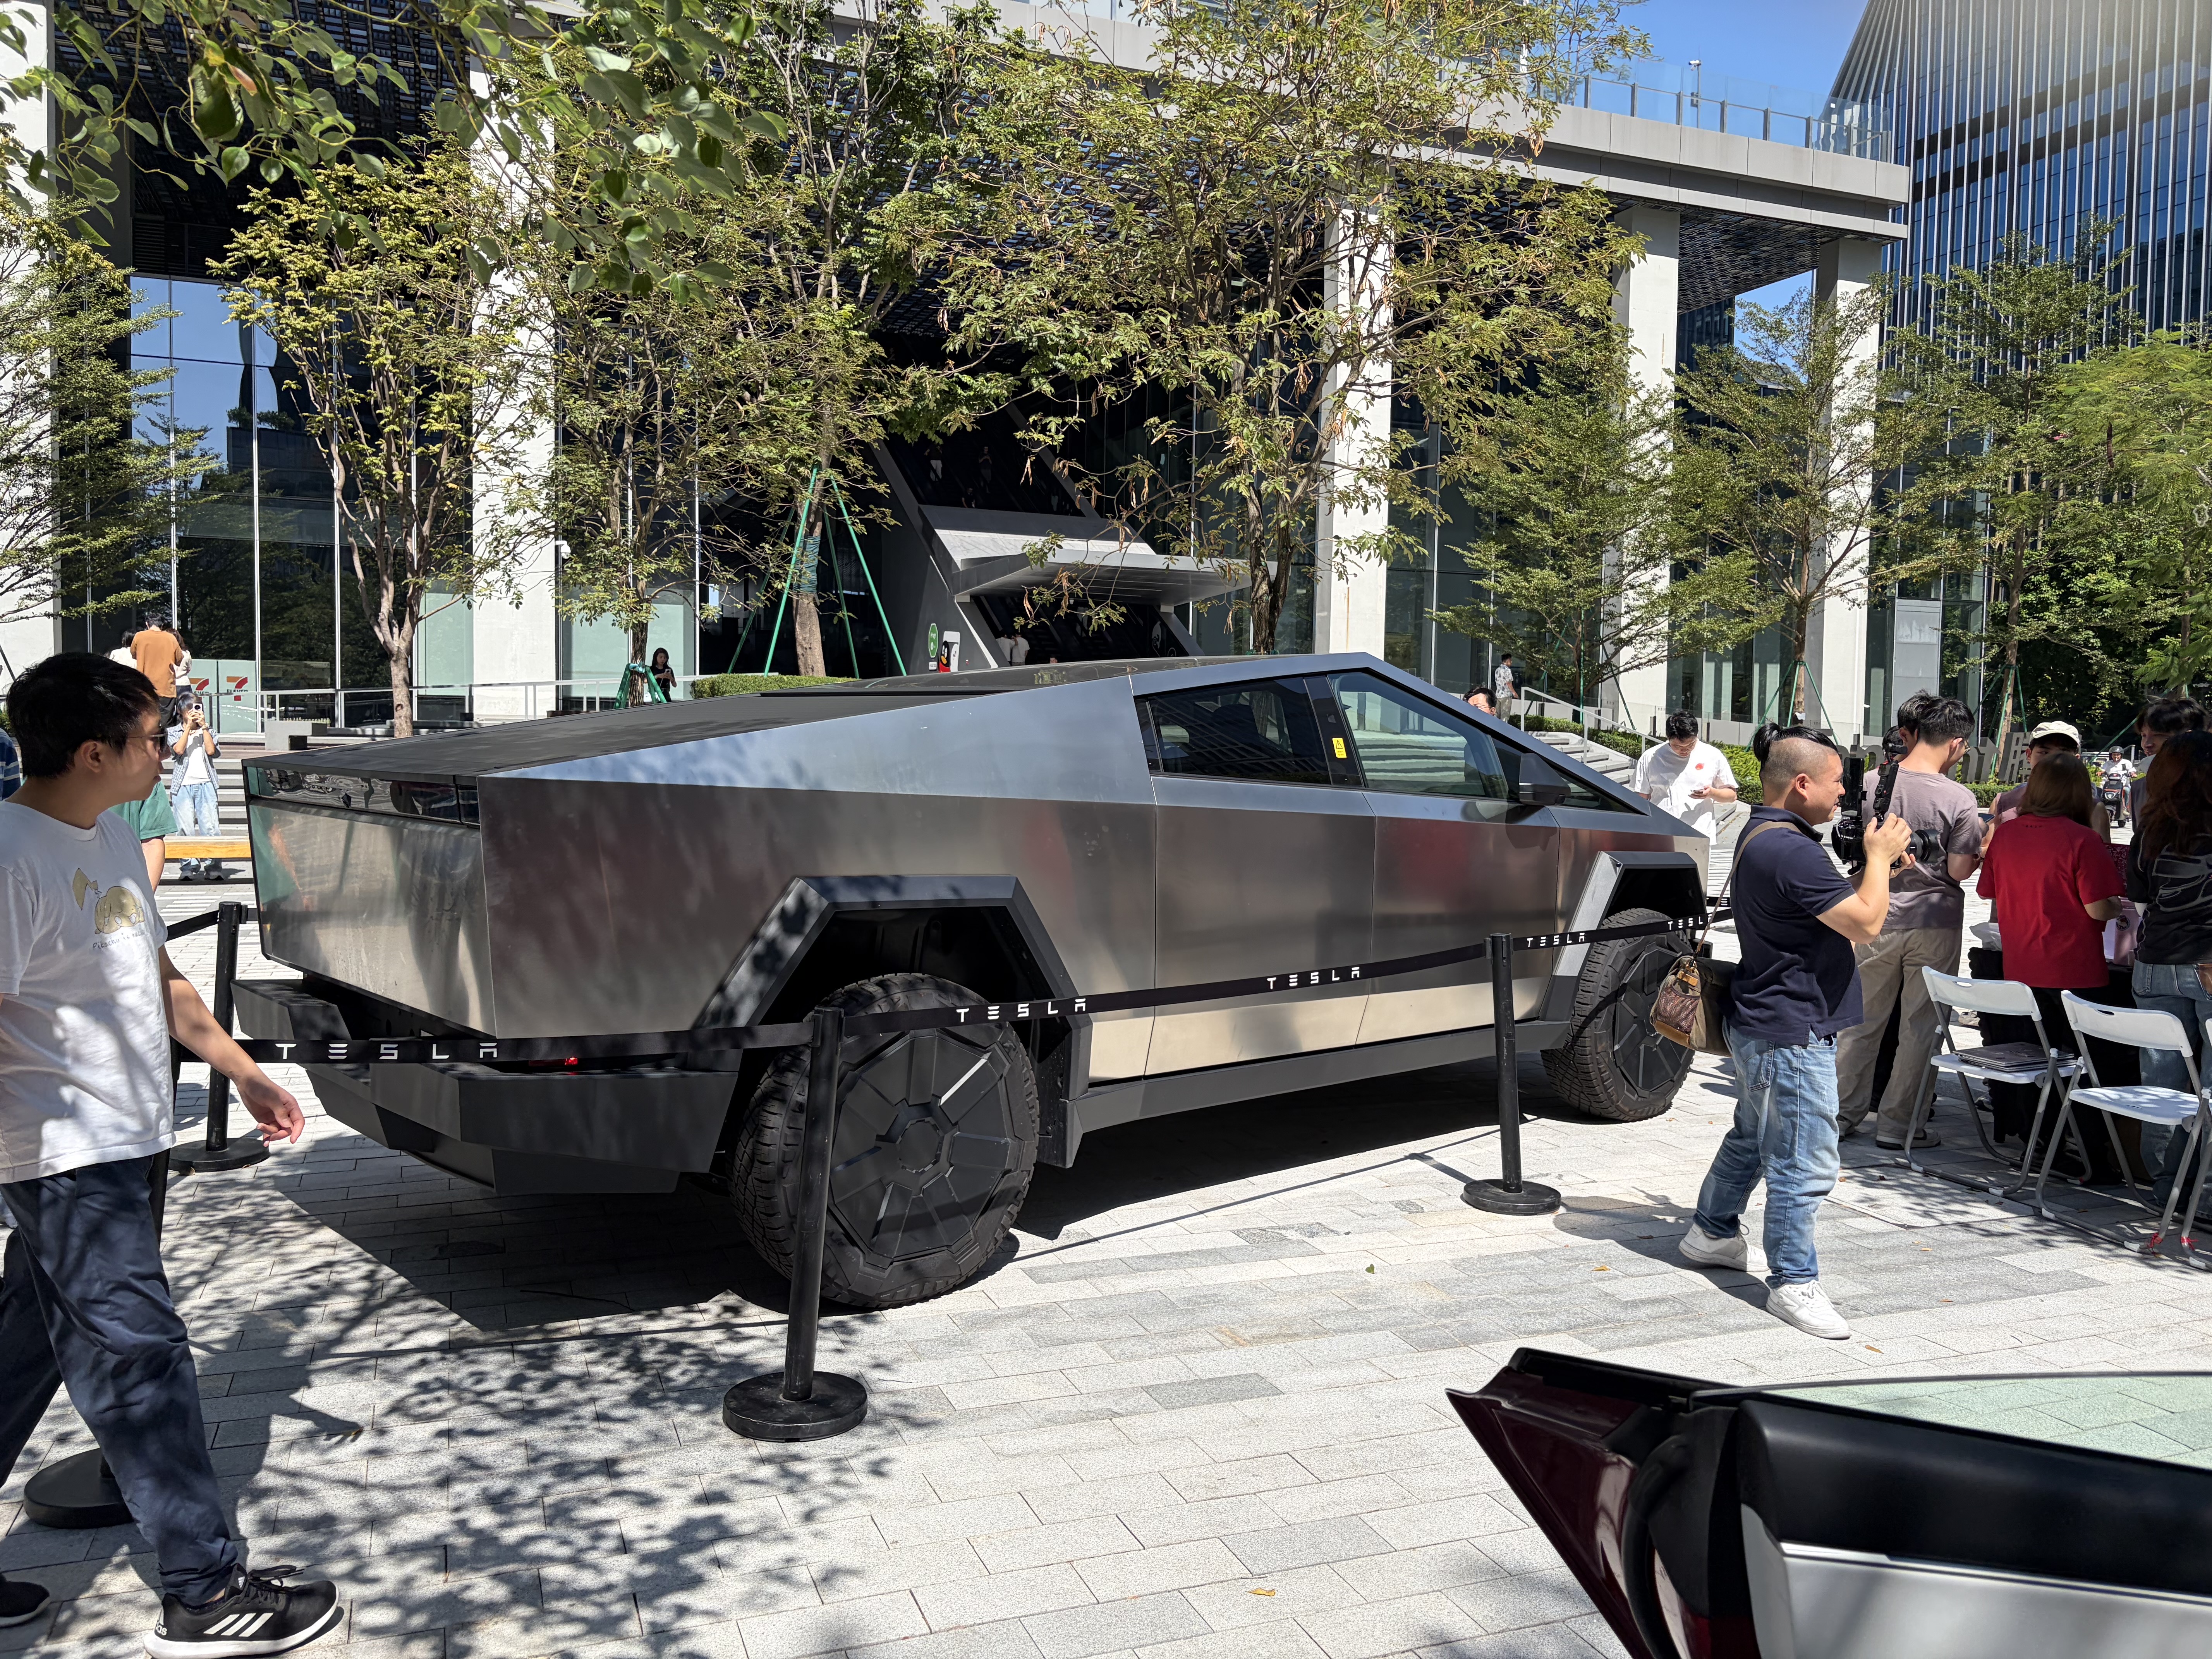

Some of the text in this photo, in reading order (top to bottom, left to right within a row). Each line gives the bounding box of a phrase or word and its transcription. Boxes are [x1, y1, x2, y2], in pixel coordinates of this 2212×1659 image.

[227, 676, 248, 701] 7
[93, 937, 120, 950] Pikachu
[121, 932, 130, 940] is
[1527, 933, 1585, 948] TESLA
[1267, 967, 1360, 989] TESLA
[956, 998, 1086, 1022] TESLA
[275, 1042, 497, 1060] TESLA
